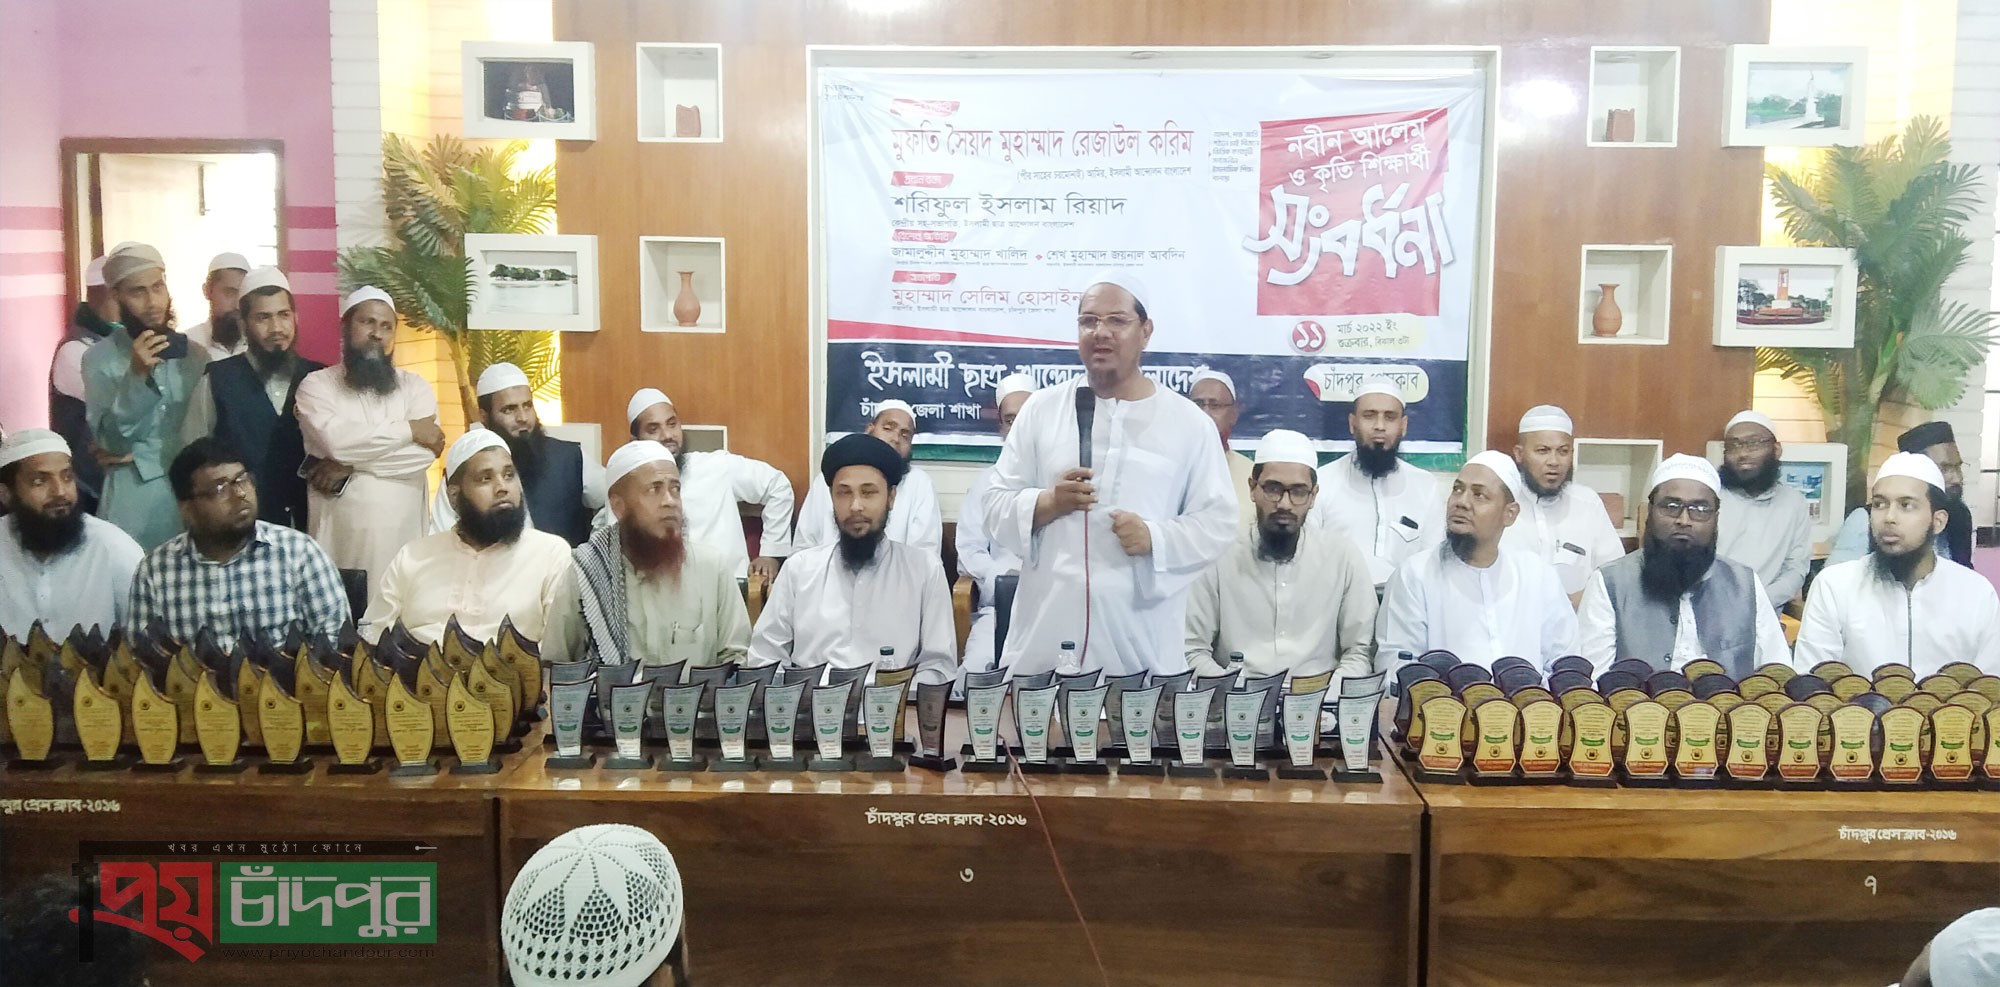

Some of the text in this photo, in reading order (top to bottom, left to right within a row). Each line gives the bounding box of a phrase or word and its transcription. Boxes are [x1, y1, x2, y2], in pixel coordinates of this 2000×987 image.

[891, 120, 941, 163] মুফতি
[945, 124, 993, 157] সৈয়দ
[999, 128, 1065, 164] মুহাম্মাদ
[1072, 124, 1142, 157] রেজাউল
[1147, 120, 1195, 157] করিম
[1285, 125, 1344, 159] নবীন
[1349, 118, 1428, 149] আলেম
[1289, 143, 1431, 193] ও কৃতি শিক্ষার্থী
[890, 190, 1128, 219] শরিফুল ইসলাম রিয়াদ
[1242, 182, 1455, 286] সংবর্ধনা
[996, 247, 1028, 260] খালিদ
[1047, 249, 1067, 260] শেখ
[892, 286, 1083, 306] মুহাম্মাদ সেলিম হোসাইন
[1296, 323, 1322, 348] ১১
[1337, 321, 1352, 334] মার্চ
[1356, 322, 1383, 333] ২০২২
[861, 350, 955, 391] ইসলামী
[1324, 366, 1364, 395] চাঁদপুর
[911, 402, 981, 420] জেলা শাখা
[865, 807, 915, 827] চাঁদপুর
[1838, 825, 1877, 844] চাঁদপুর
[959, 867, 974, 882] ৩
[1864, 875, 1877, 895] ৭
